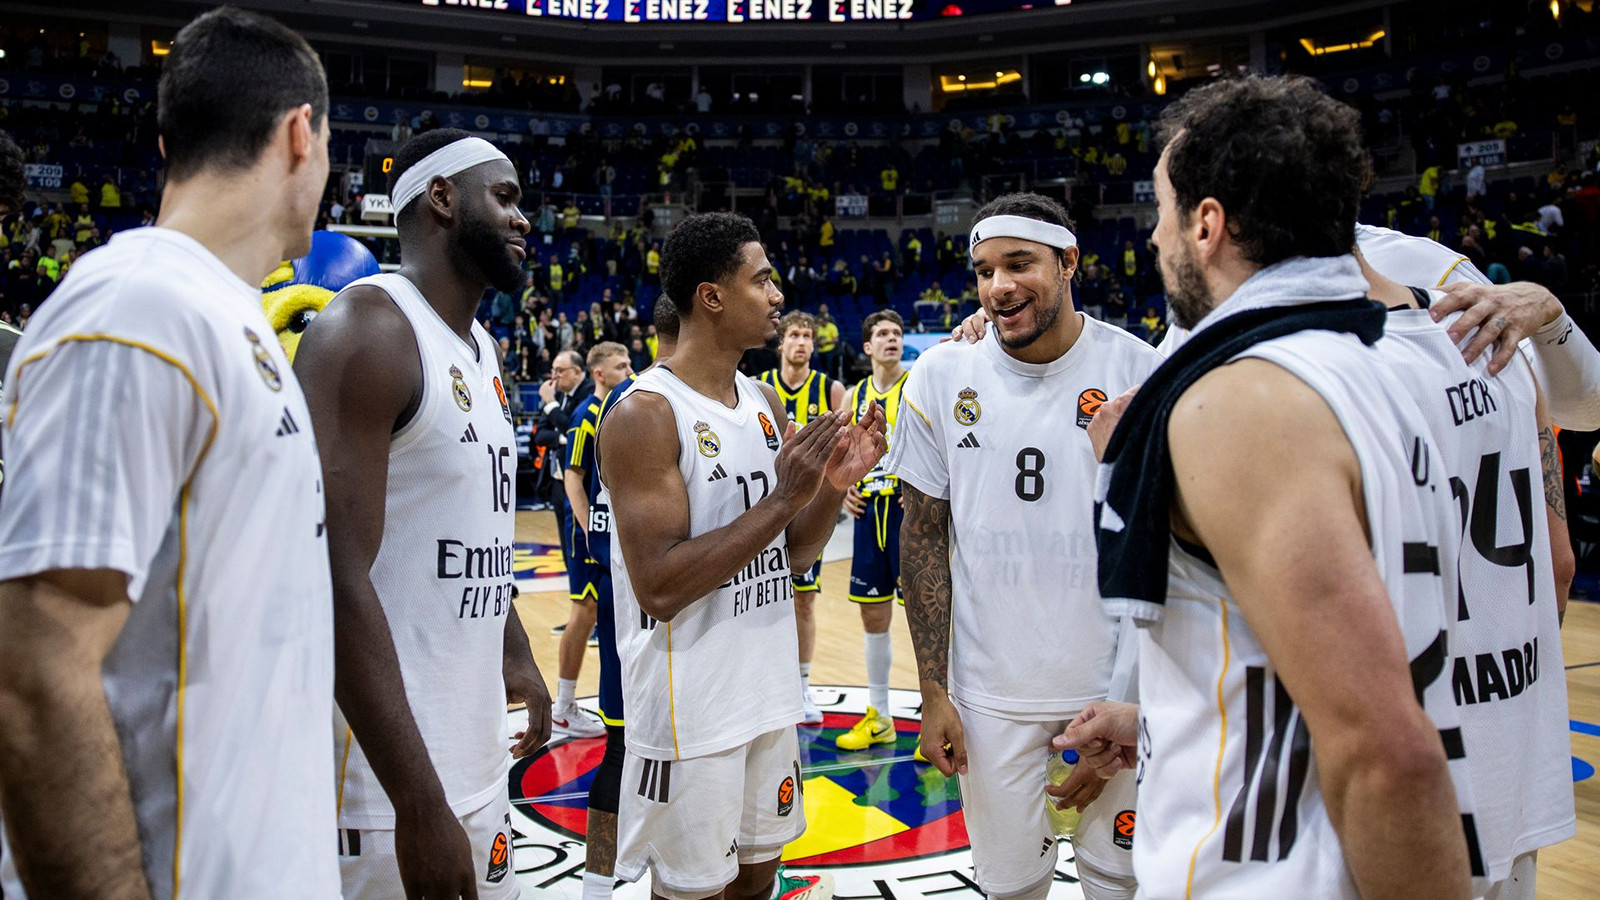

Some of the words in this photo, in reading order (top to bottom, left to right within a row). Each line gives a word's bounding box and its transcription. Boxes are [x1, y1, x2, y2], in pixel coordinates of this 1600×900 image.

[548, 0, 609, 19] ENEZ
[646, 0, 708, 20] ENEZ
[749, 0, 812, 20] ENEZ
[851, 0, 913, 19] ENEZ
[38, 166, 61, 176] 209
[38, 178, 61, 188] 109
[1445, 377, 1497, 426] DECK
[487, 443, 511, 513] 16
[1015, 447, 1046, 502] 8
[1449, 451, 1535, 621] 24
[459, 586, 492, 618] FLY
[734, 584, 752, 617] FLY
[1452, 636, 1539, 706] MADRI
